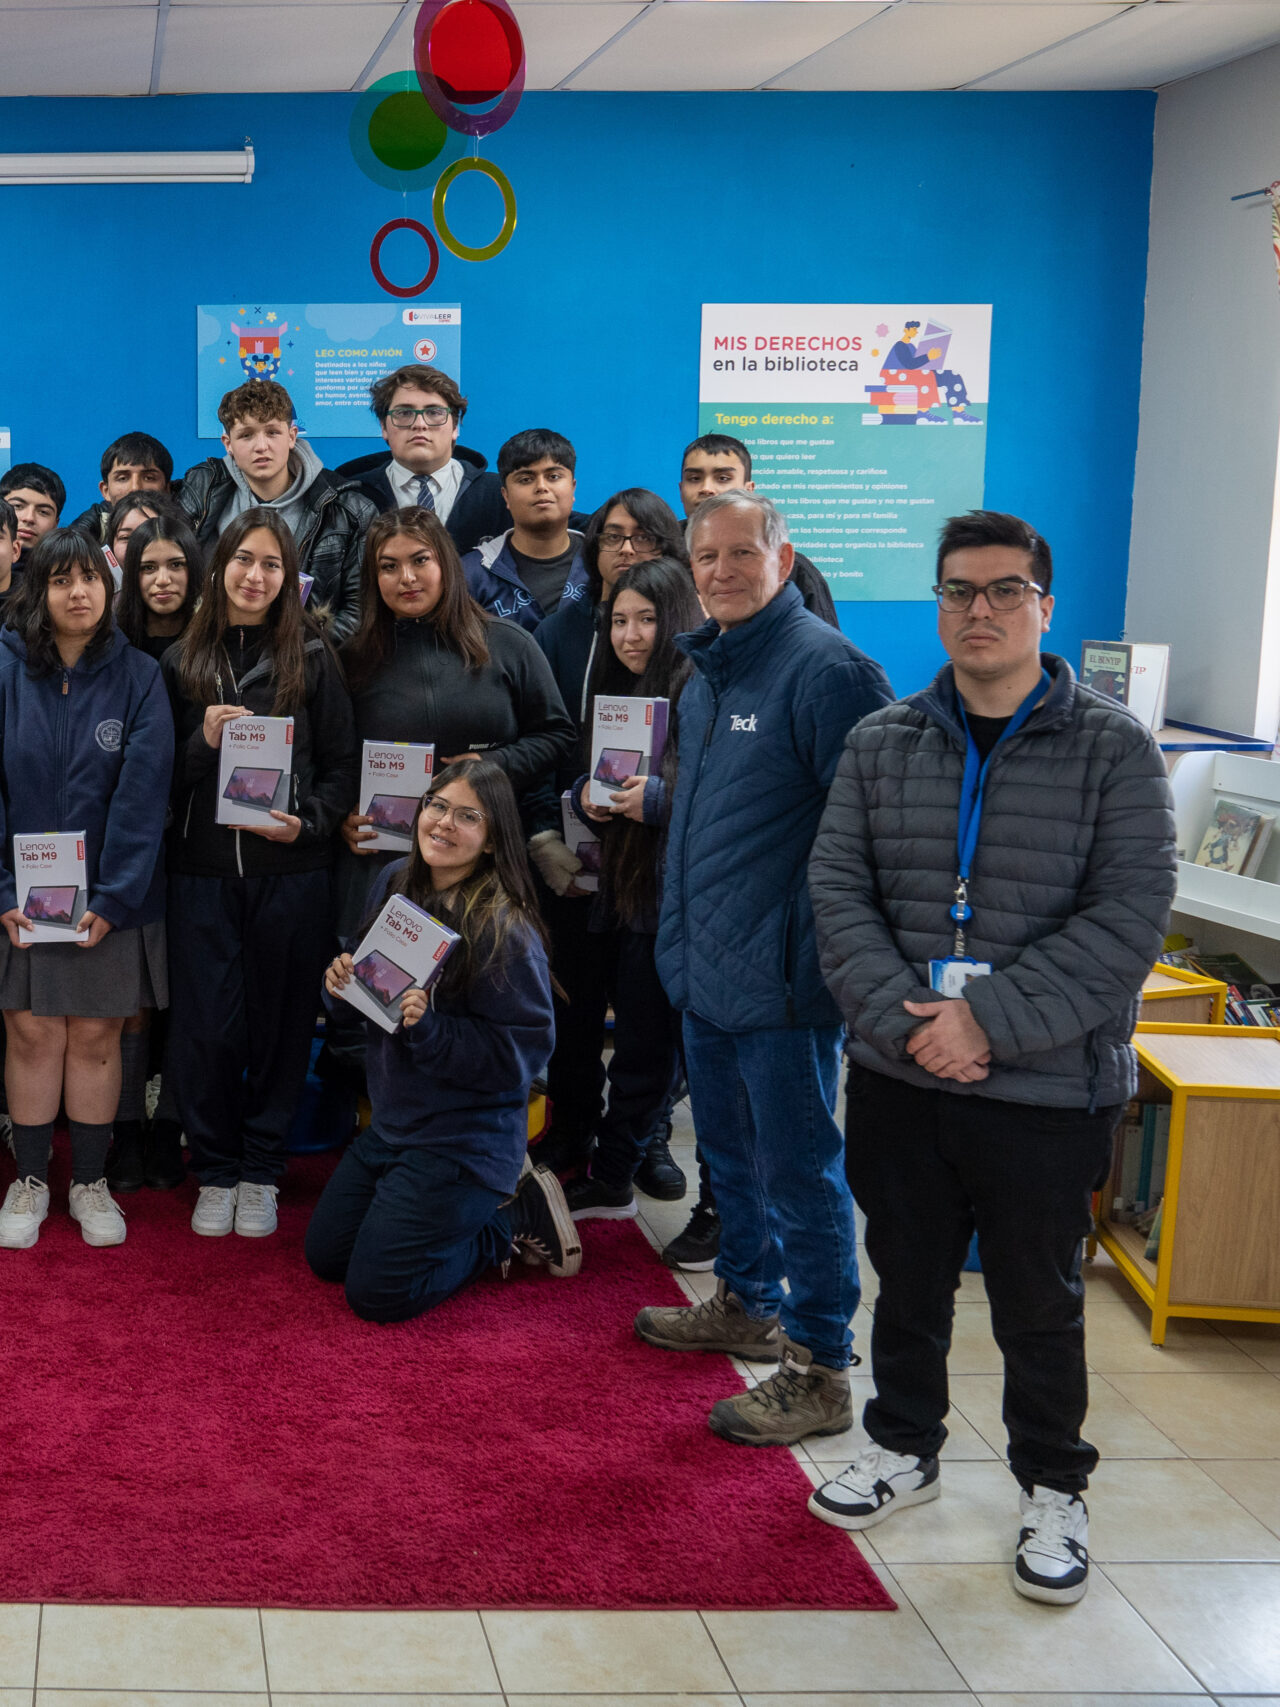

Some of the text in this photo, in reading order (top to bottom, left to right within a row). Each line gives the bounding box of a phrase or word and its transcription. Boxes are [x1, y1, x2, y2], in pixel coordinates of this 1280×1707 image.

[714, 336, 862, 351] MIS DERECHOS
[315, 348, 402, 357] LEO COMO AVIÓN
[713, 357, 859, 371] en la biblioteca
[715, 413, 834, 426] Tengo derecho a:
[599, 702, 628, 712] Lenovo
[598, 713, 628, 722] Tab M9
[730, 714, 758, 731] Teck
[229, 722, 265, 731] Lenovo
[229, 732, 266, 742] Tab M9
[368, 750, 404, 760] Lenovo
[368, 760, 405, 770] Tab M9
[20, 843, 56, 851] Lenovo
[20, 852, 57, 861] Tab M9
[390, 905, 422, 932] Lenovo
[385, 914, 418, 942] Tab M9
